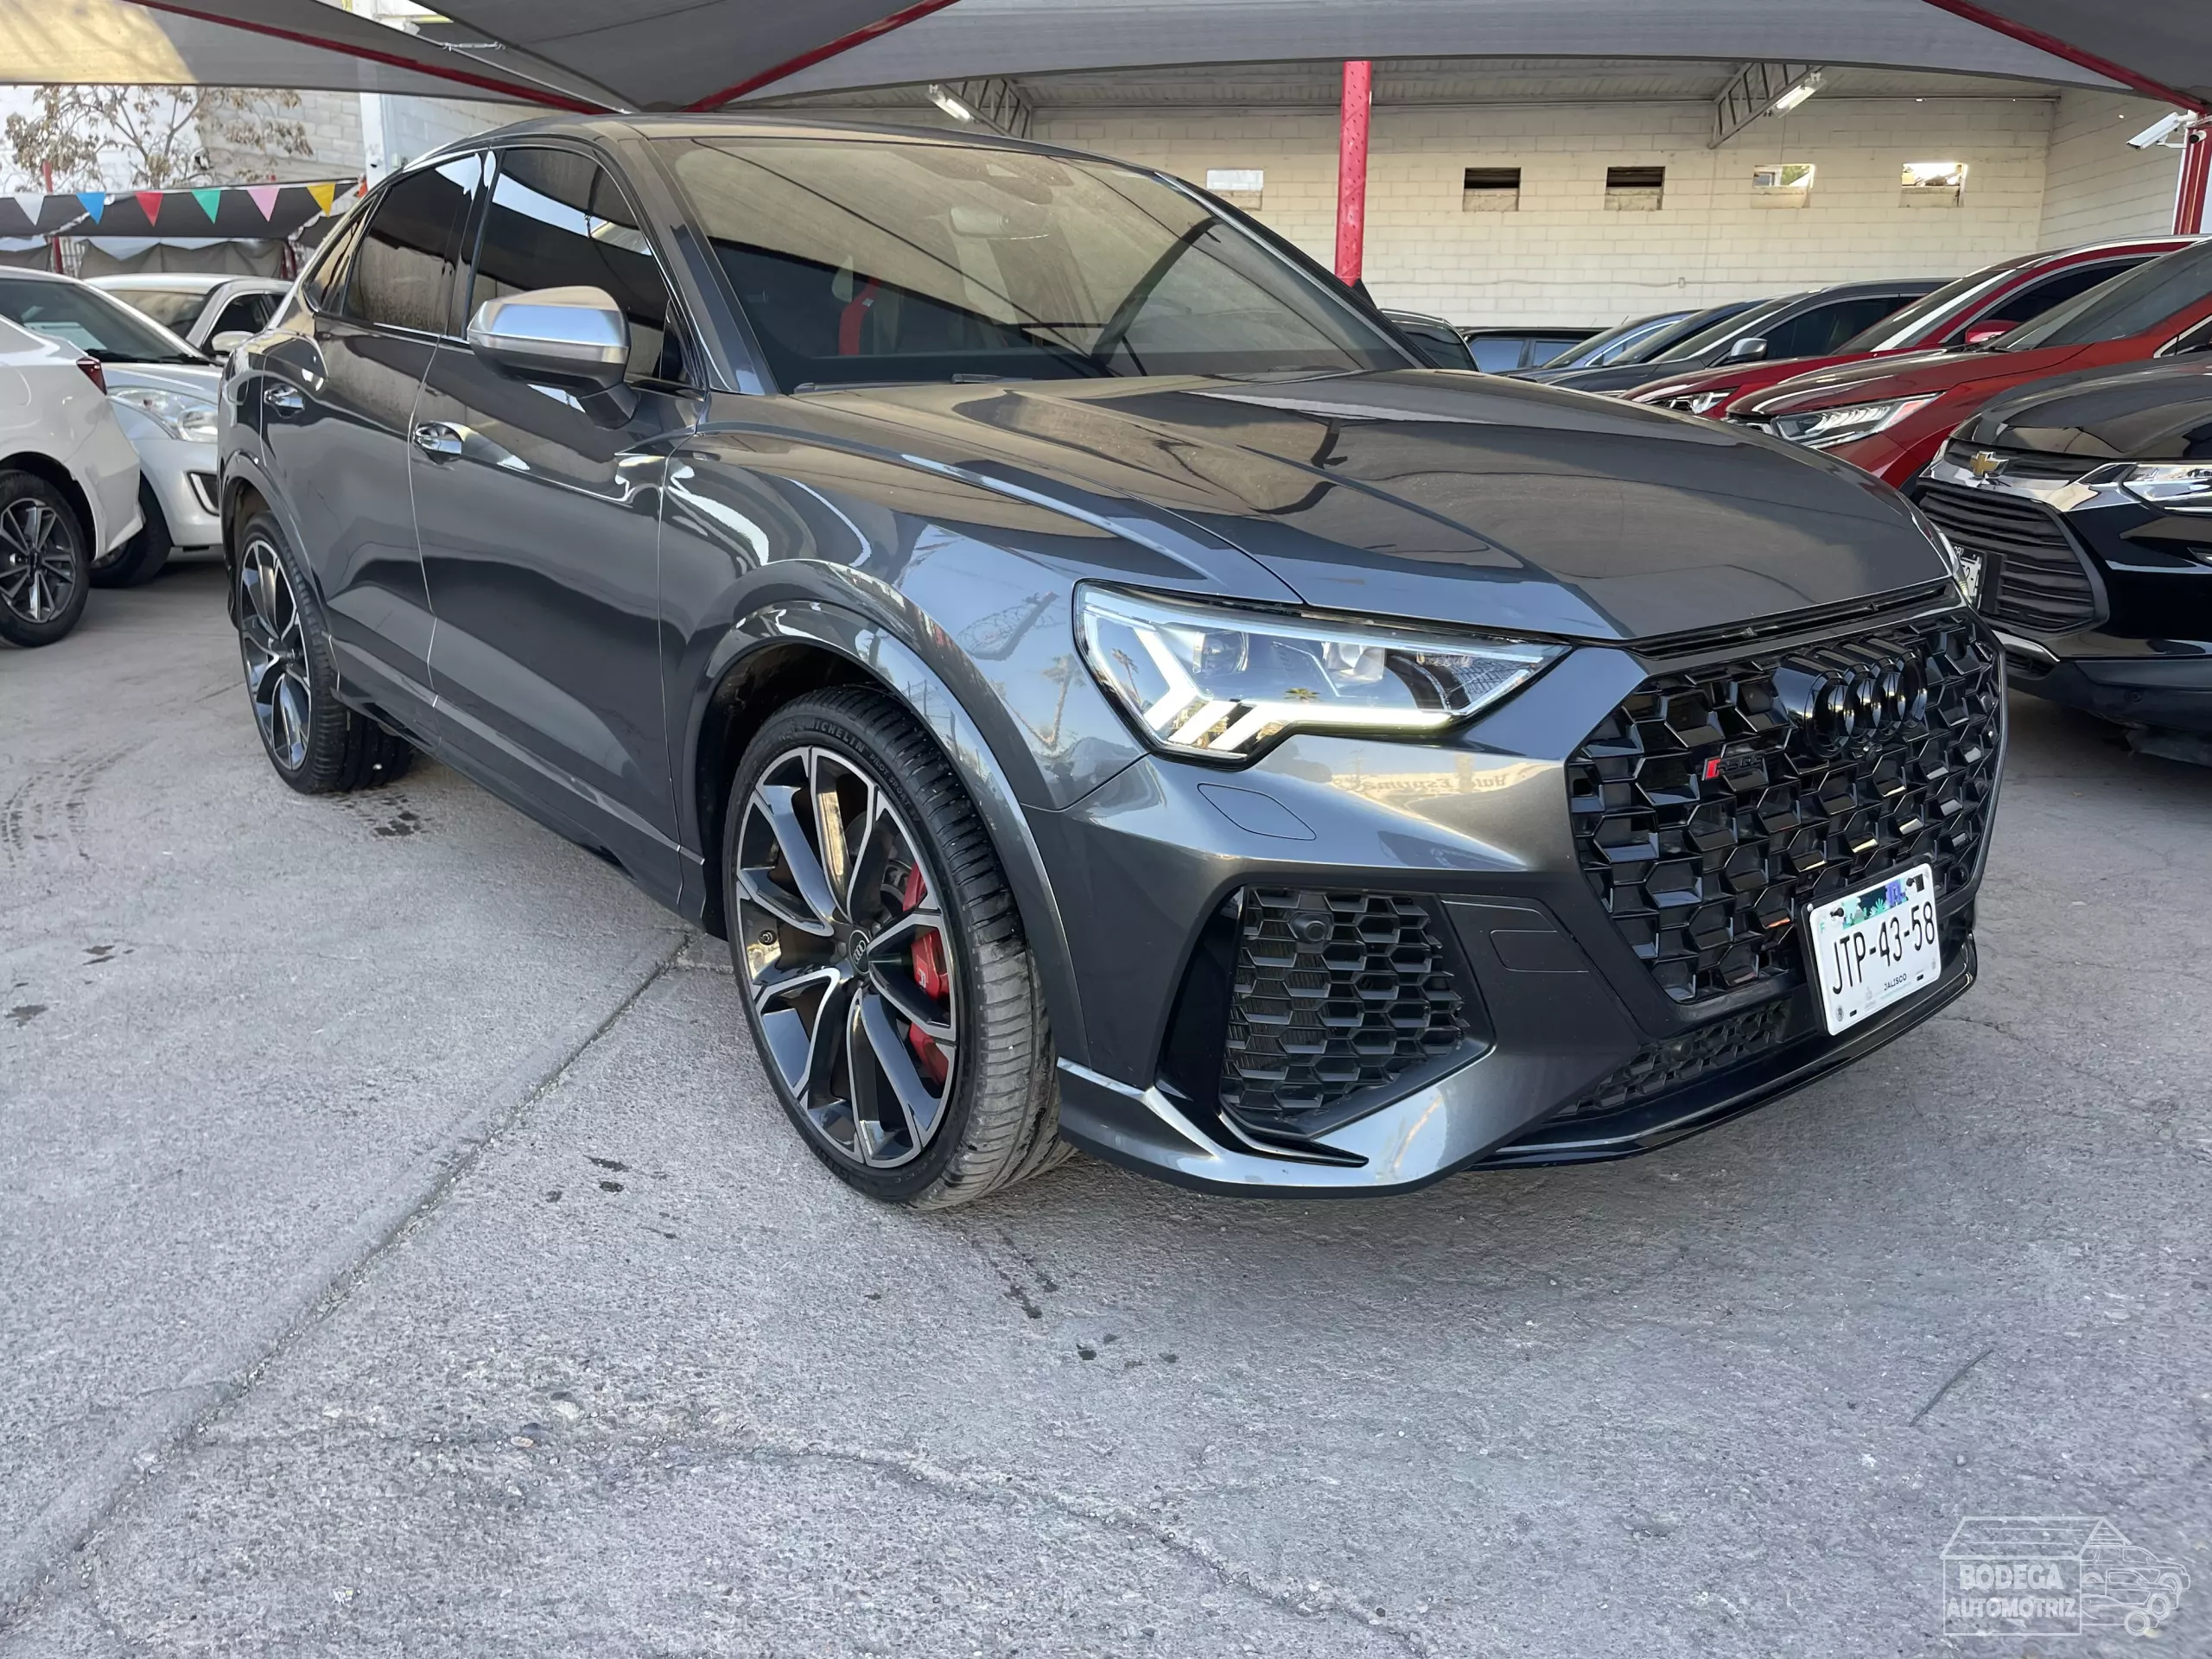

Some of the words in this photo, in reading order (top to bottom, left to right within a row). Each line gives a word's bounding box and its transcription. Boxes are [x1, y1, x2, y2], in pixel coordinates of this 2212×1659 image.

[807, 719, 866, 753] MICHELIN
[869, 754, 889, 776] PILOT
[888, 778, 913, 805] SPORT
[1833, 900, 1936, 995] JTP-43-58
[1884, 973, 1907, 992] JALISCO
